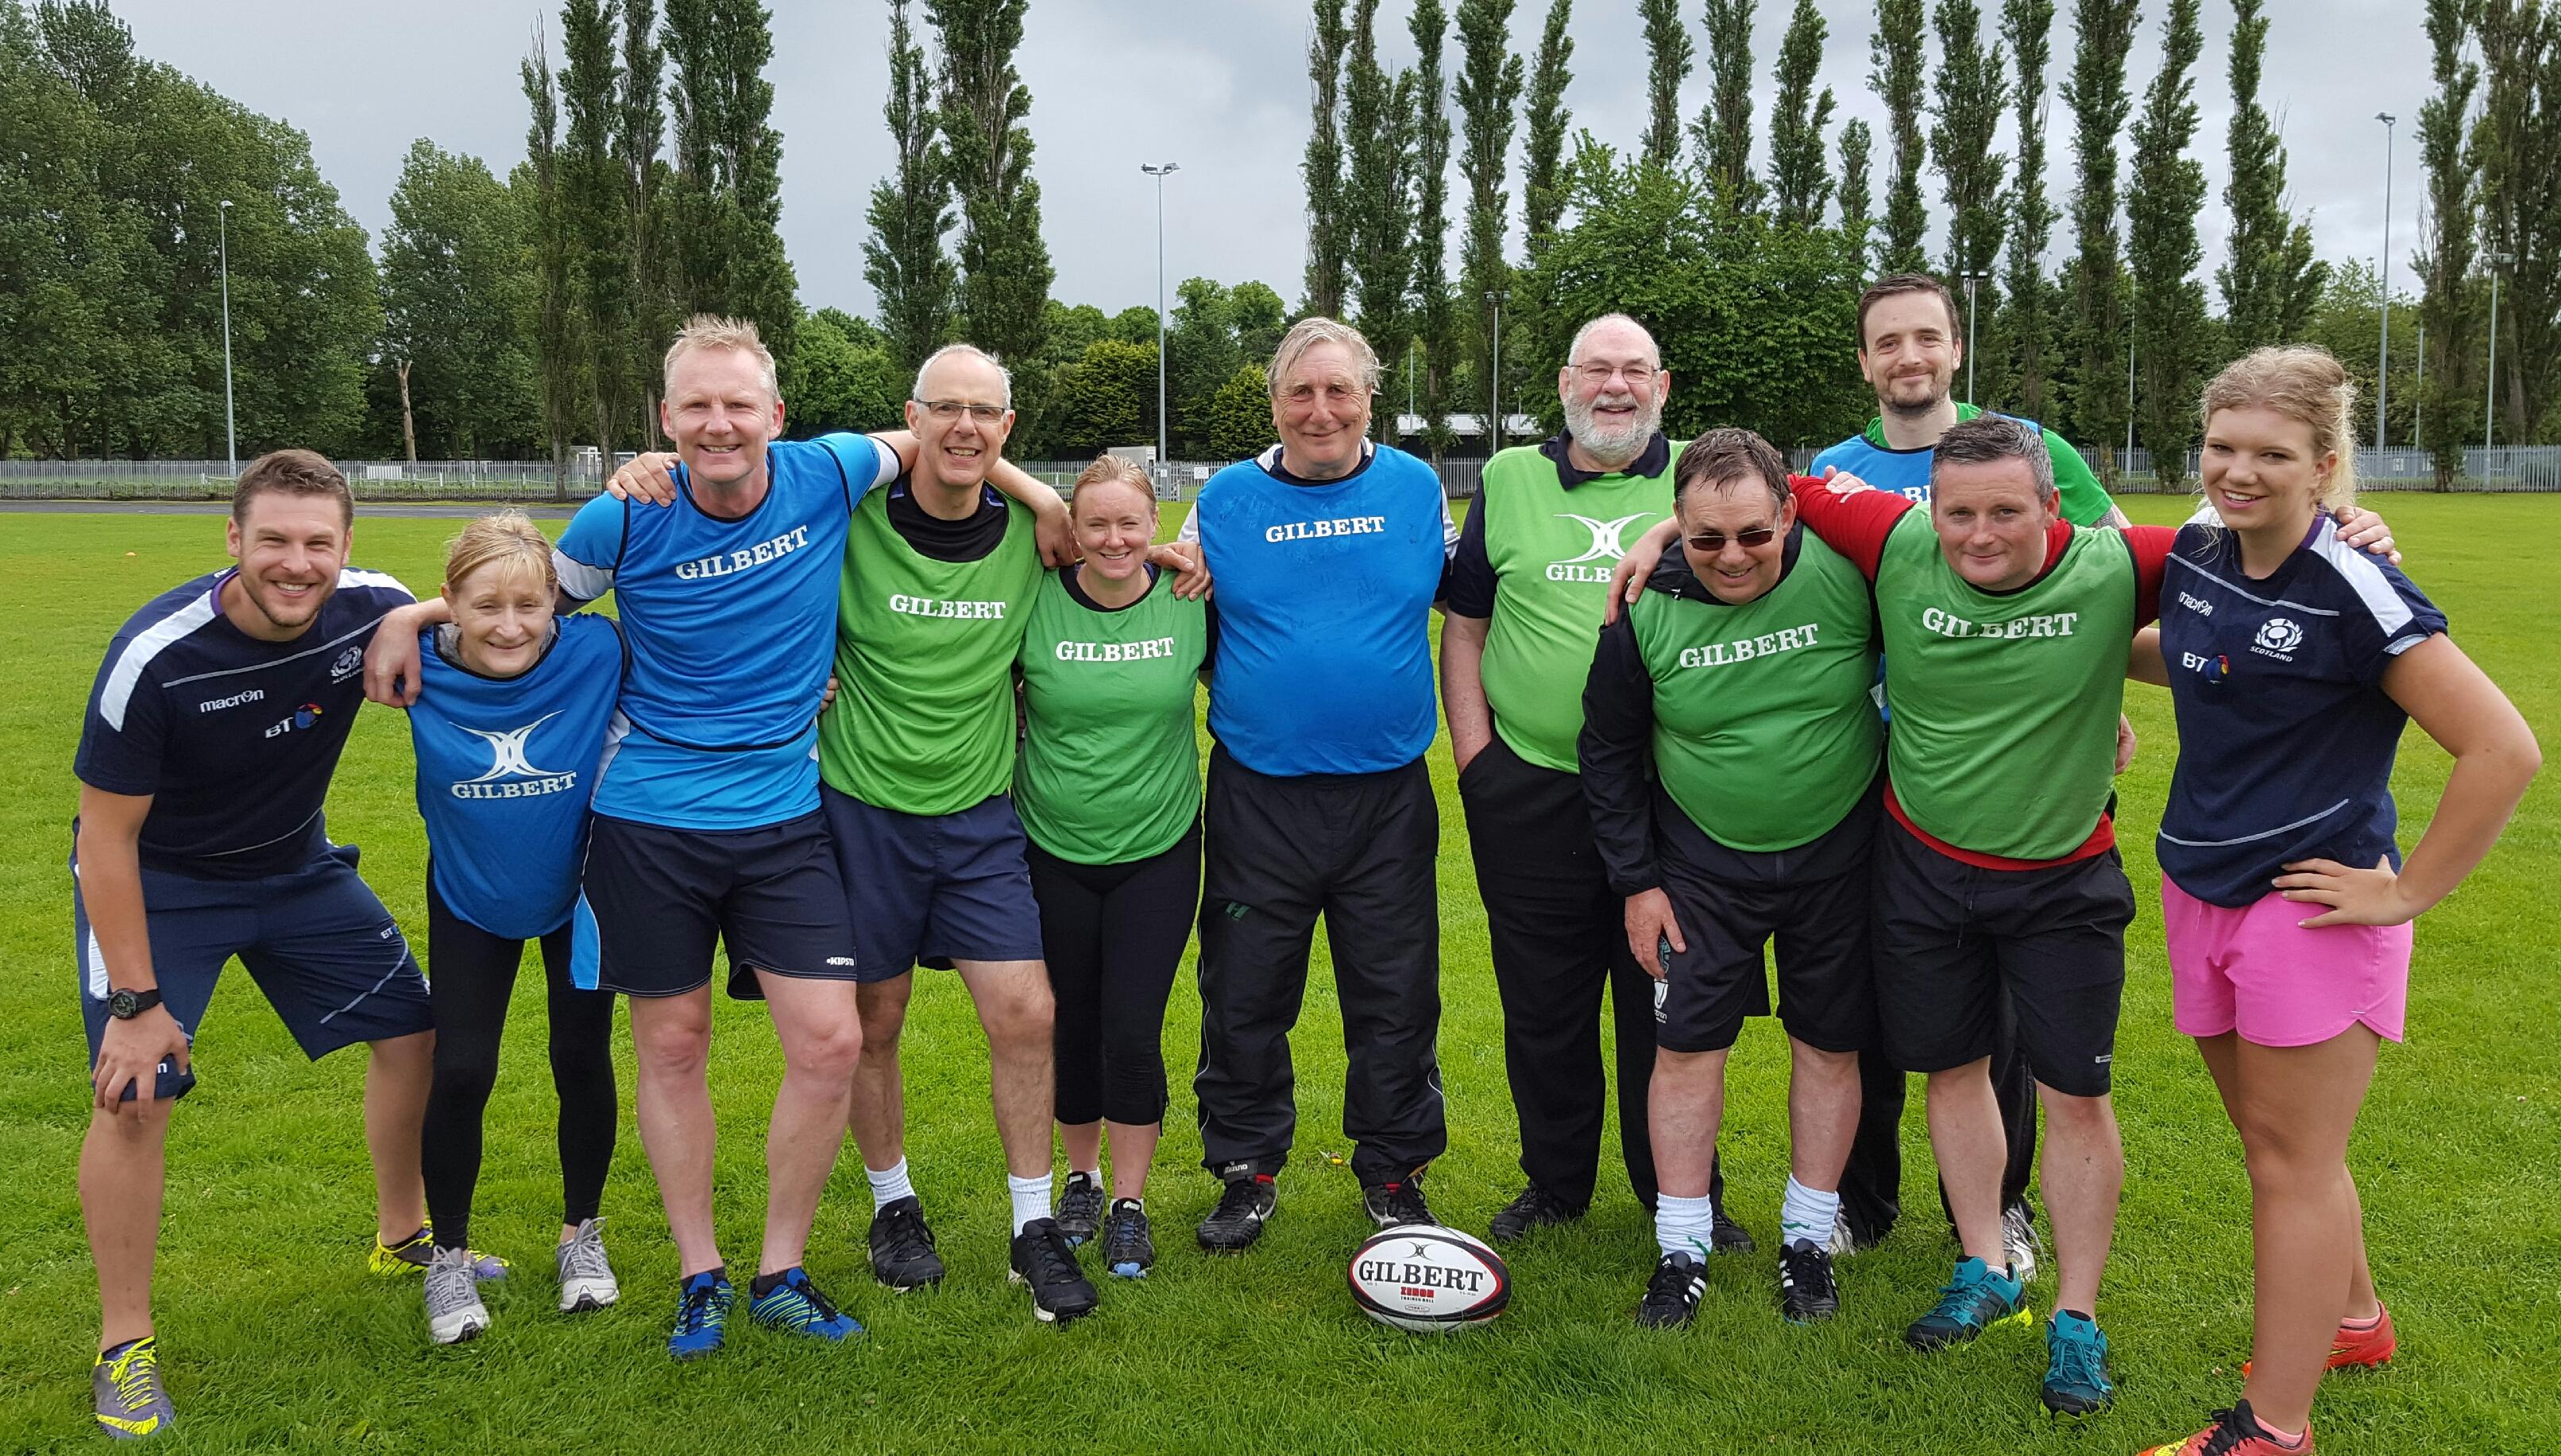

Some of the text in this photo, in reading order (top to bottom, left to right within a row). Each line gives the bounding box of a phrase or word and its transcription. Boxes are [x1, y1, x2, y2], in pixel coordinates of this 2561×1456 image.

[1265, 516, 1385, 543] GILBERT
[676, 525, 809, 579] GILBERT
[1546, 564, 1616, 582] GILB
[889, 594, 1006, 620] GILBERT
[1922, 608, 2077, 639] GILBERT
[1056, 637, 1175, 662] GILBERT
[1679, 624, 1819, 668] GILBERT
[2250, 646, 2293, 662] SCOTLAND
[2182, 651, 2208, 672] BT
[200, 689, 265, 713] macron
[265, 716, 294, 738] BT
[451, 772, 577, 798] GILBERT
[1359, 1260, 1483, 1292] GILBERT
